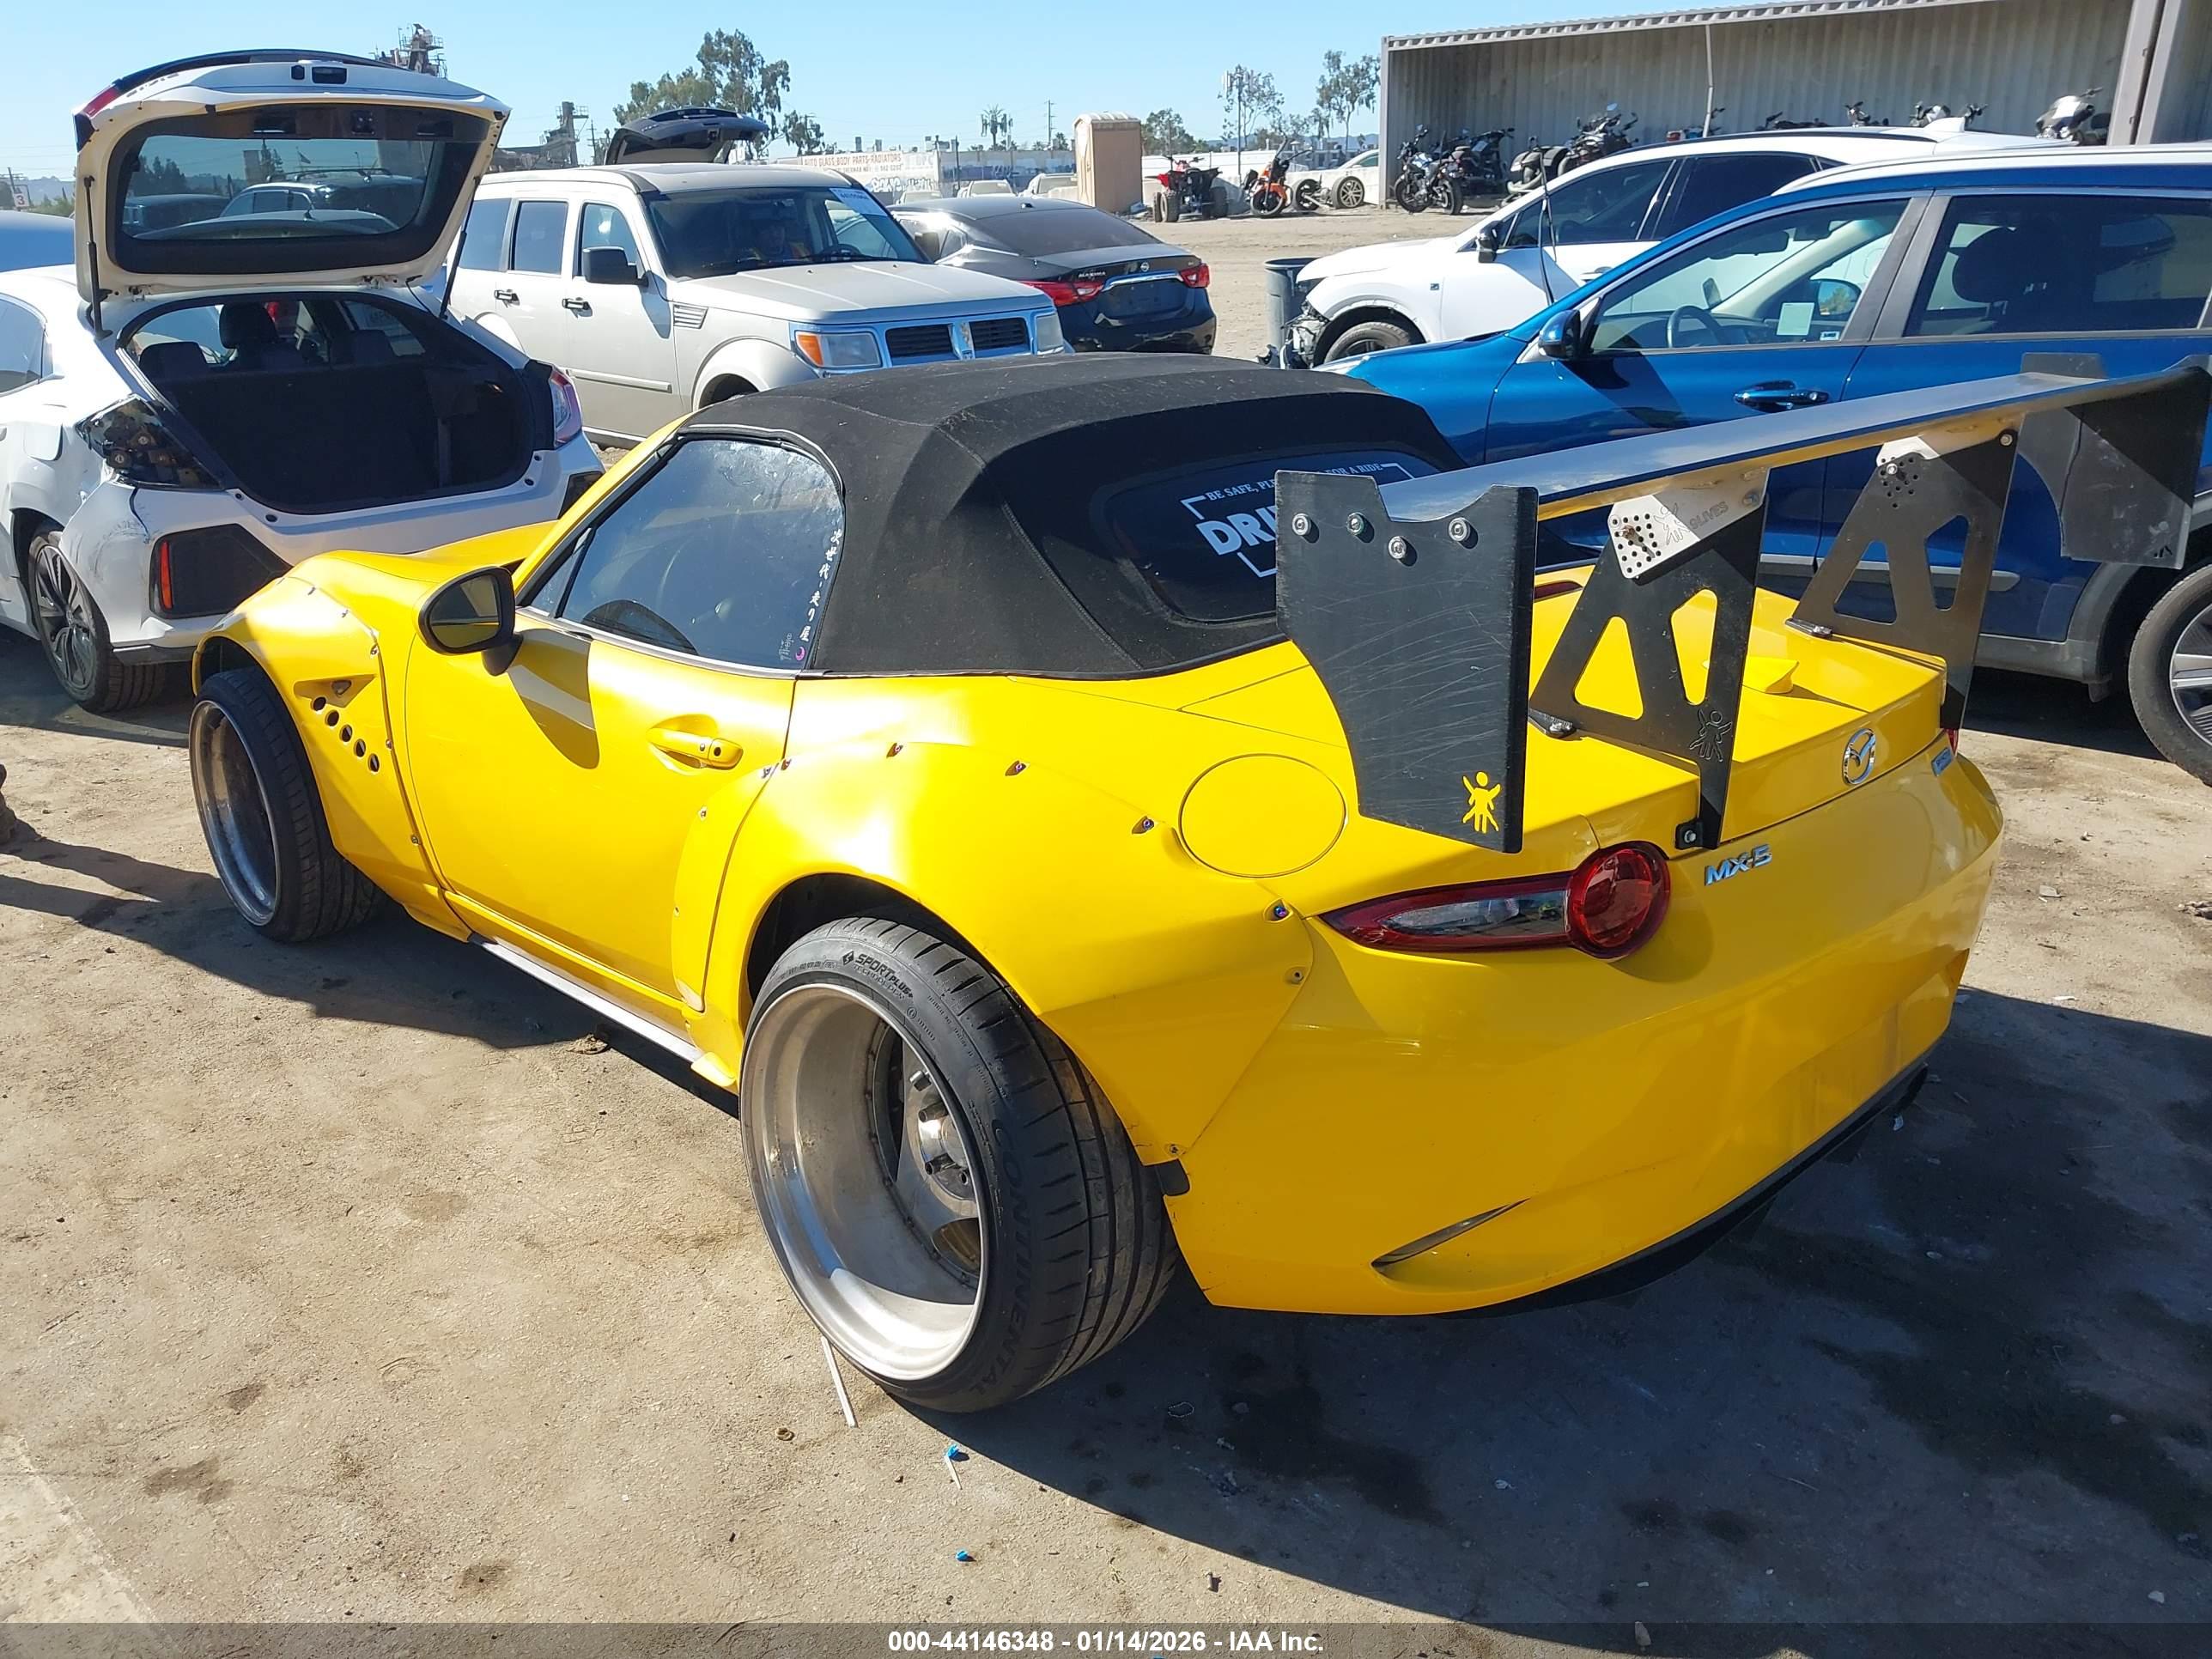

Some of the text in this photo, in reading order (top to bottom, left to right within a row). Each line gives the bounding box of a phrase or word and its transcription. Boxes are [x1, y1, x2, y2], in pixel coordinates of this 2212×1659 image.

[16, 194, 26, 205] 3
[1206, 489, 1225, 501] BE
[1224, 483, 1260, 497] SAFE,
[1356, 463, 1383, 472] RIDE
[1195, 505, 1275, 556] DRI
[1705, 843, 1773, 886] MX-5
